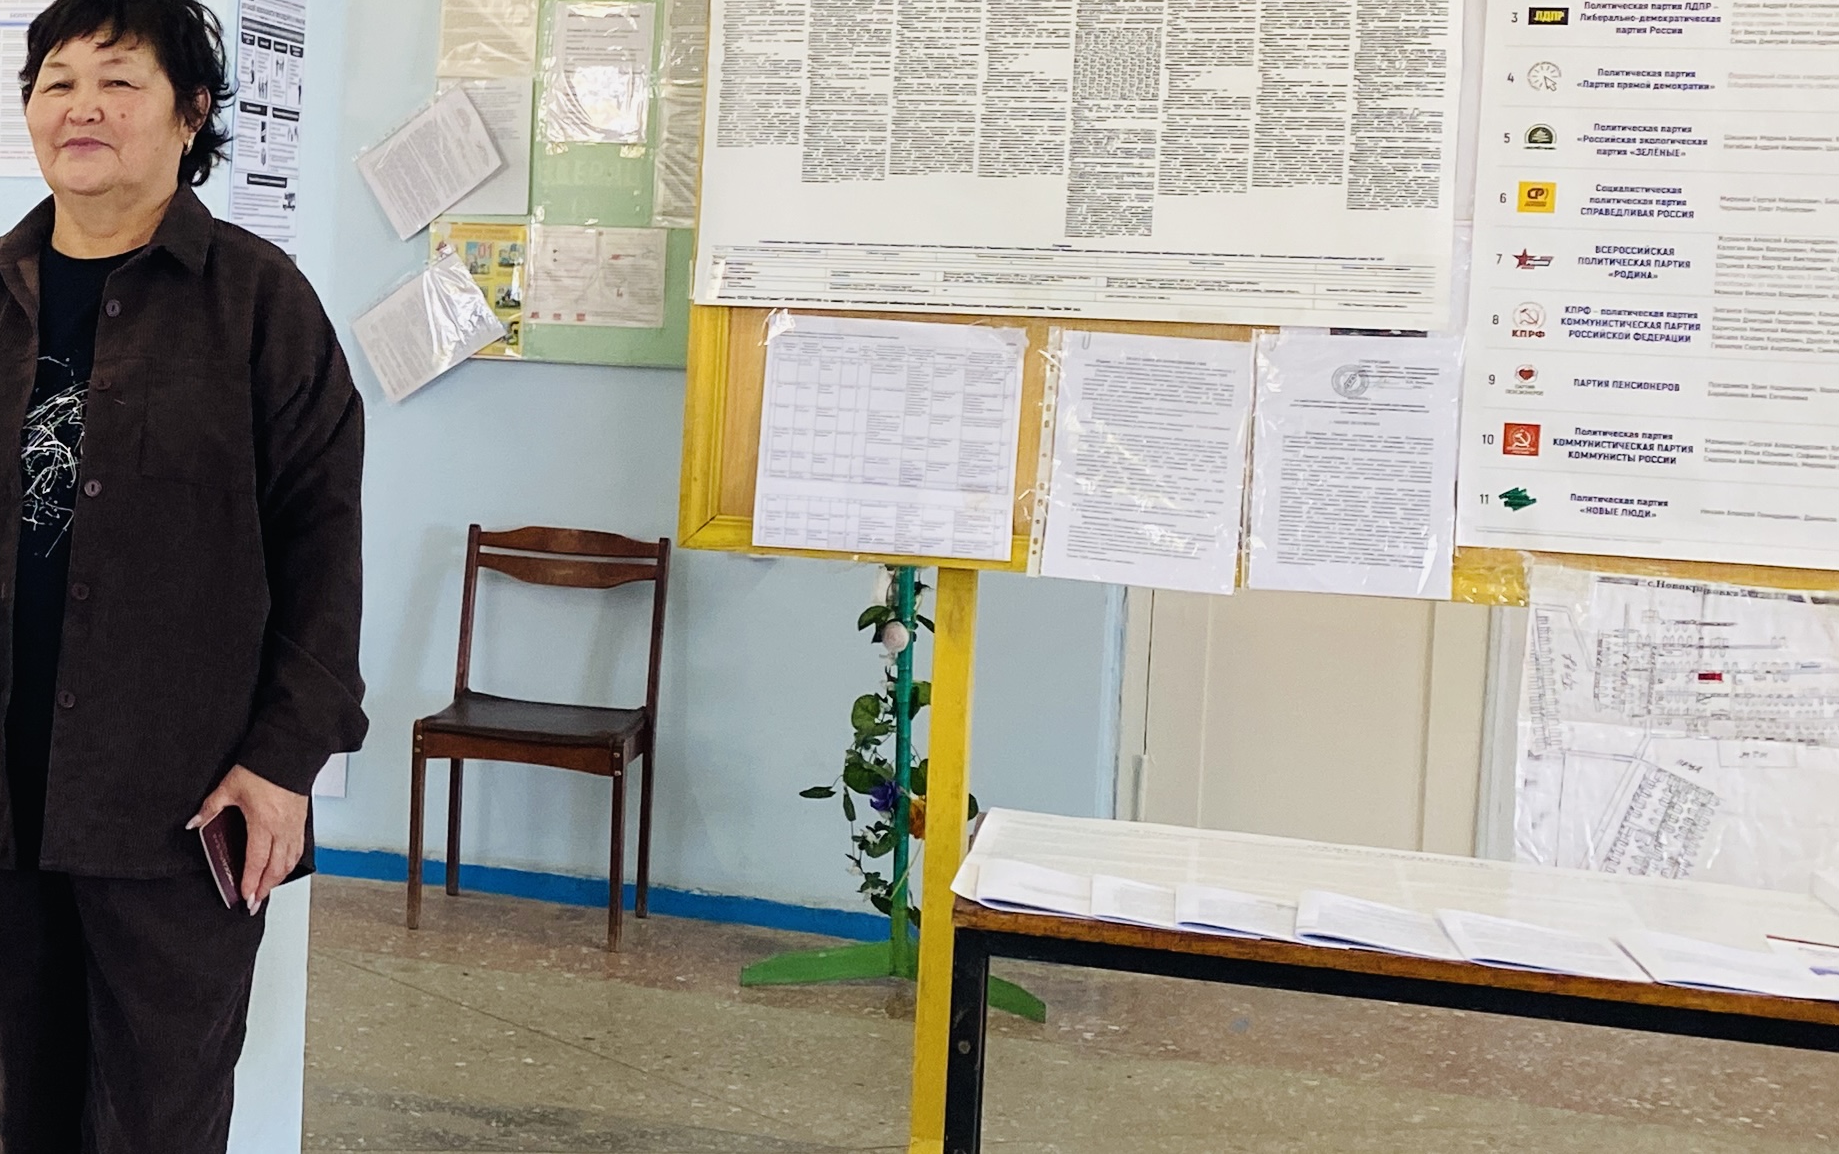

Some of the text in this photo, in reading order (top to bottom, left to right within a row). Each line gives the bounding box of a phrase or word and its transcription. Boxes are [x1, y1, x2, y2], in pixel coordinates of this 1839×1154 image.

[1584, 2, 1711, 11] Политическая партия ЛДПР
[1511, 12, 1518, 23] 3
[1534, 10, 1565, 22] ЛДПР
[1580, 13, 1721, 23] Либерально-демократическая
[1616, 27, 1647, 36] партия
[1507, 73, 1514, 83] 4
[1597, 68, 1696, 79] Политическая партия
[1577, 80, 1614, 89] «Партия
[1617, 80, 1650, 90] прямой
[1594, 123, 1692, 134] Политическая партия
[1504, 132, 1510, 144] 5
[1577, 135, 1708, 145] «Российская экологическая
[1597, 148, 1627, 157] партия
[1596, 184, 1682, 194] Социалистическая
[1500, 192, 1507, 204] 6
[1590, 197, 1687, 207] политическая партия
[1580, 208, 1695, 219] СПРАВЕДЛИВАЯ РОССИЯ
[1595, 245, 1675, 256] ВСЕРОССИЙСКАЯ
[1496, 254, 1503, 265] 7
[1578, 257, 1691, 268] ПОЛИТИЧЕСКАЯ ПАРТИЯ
[1608, 270, 1658, 280] «РОДИНА»
[1565, 306, 1698, 320] КПРФ политическая партия
[1492, 314, 1499, 325] 8
[1561, 318, 1701, 331] КОММУНИСТИЧЕСКАЯ ПАРТИЯ
[1512, 330, 1545, 338] КПРФ
[1569, 329, 1691, 343] РОССИЙСКОЙ ФЕДЕРАЦИИ
[1489, 374, 1495, 385] 9
[1574, 379, 1680, 392] ПАРТИЯ ПЕНСИОНЕРОВ
[1575, 427, 1673, 440] Политическая партия
[1482, 434, 1494, 445] 10
[1553, 438, 1694, 454] КОММУНИСТИЧЕСКАЯ ПАРТИЯ
[1568, 451, 1676, 464] КОММУНИСТЫ РОССИИ
[1480, 494, 1489, 505] 11
[1570, 493, 1668, 507] Политическая партия
[1580, 506, 1657, 518] «НОВЫЕ ЛЮДИ»
